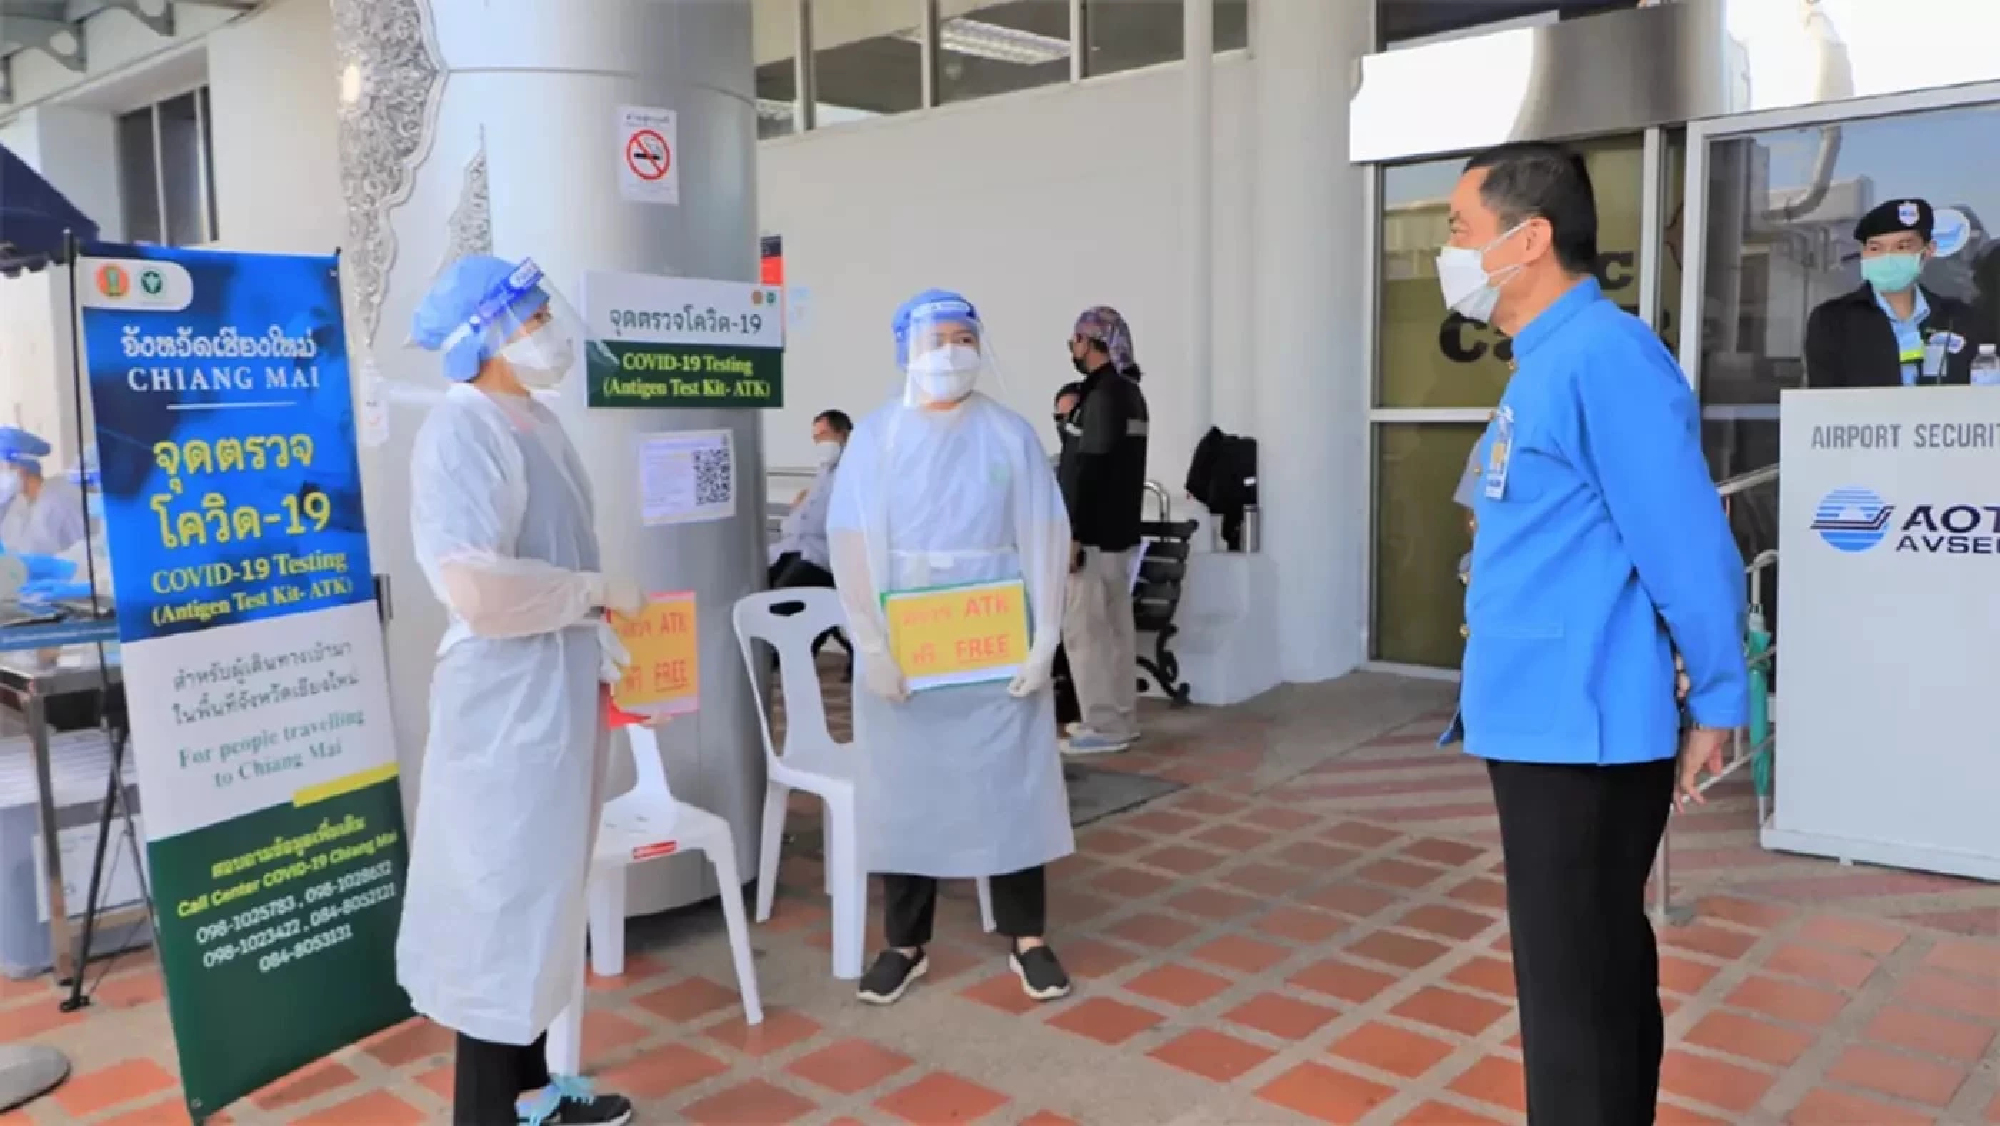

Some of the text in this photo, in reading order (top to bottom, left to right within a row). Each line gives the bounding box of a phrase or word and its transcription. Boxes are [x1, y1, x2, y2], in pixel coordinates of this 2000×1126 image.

[610, 304, 762, 337] จุดตรวจโควิด-19
[127, 366, 320, 391] CHIANG MAI
[622, 353, 753, 376] COVID-19 Testing
[669, 378, 700, 397] Test
[1811, 424, 1901, 449] AIRPORT
[153, 433, 313, 493] จุดตรวจ
[151, 491, 331, 548] โควิด-19
[153, 550, 348, 594] COVID-19 Testing
[153, 600, 231, 627] (Antigen
[231, 592, 268, 611] Test
[310, 576, 354, 599] ATK)
[965, 594, 1010, 619] ATK
[956, 634, 1010, 659] FREE
[655, 660, 688, 687] FREE
[180, 711, 364, 769] For people travelling
[215, 738, 342, 788] to Chiang Mai
[177, 894, 209, 917] Call
[263, 853, 328, 887] COVID-19
